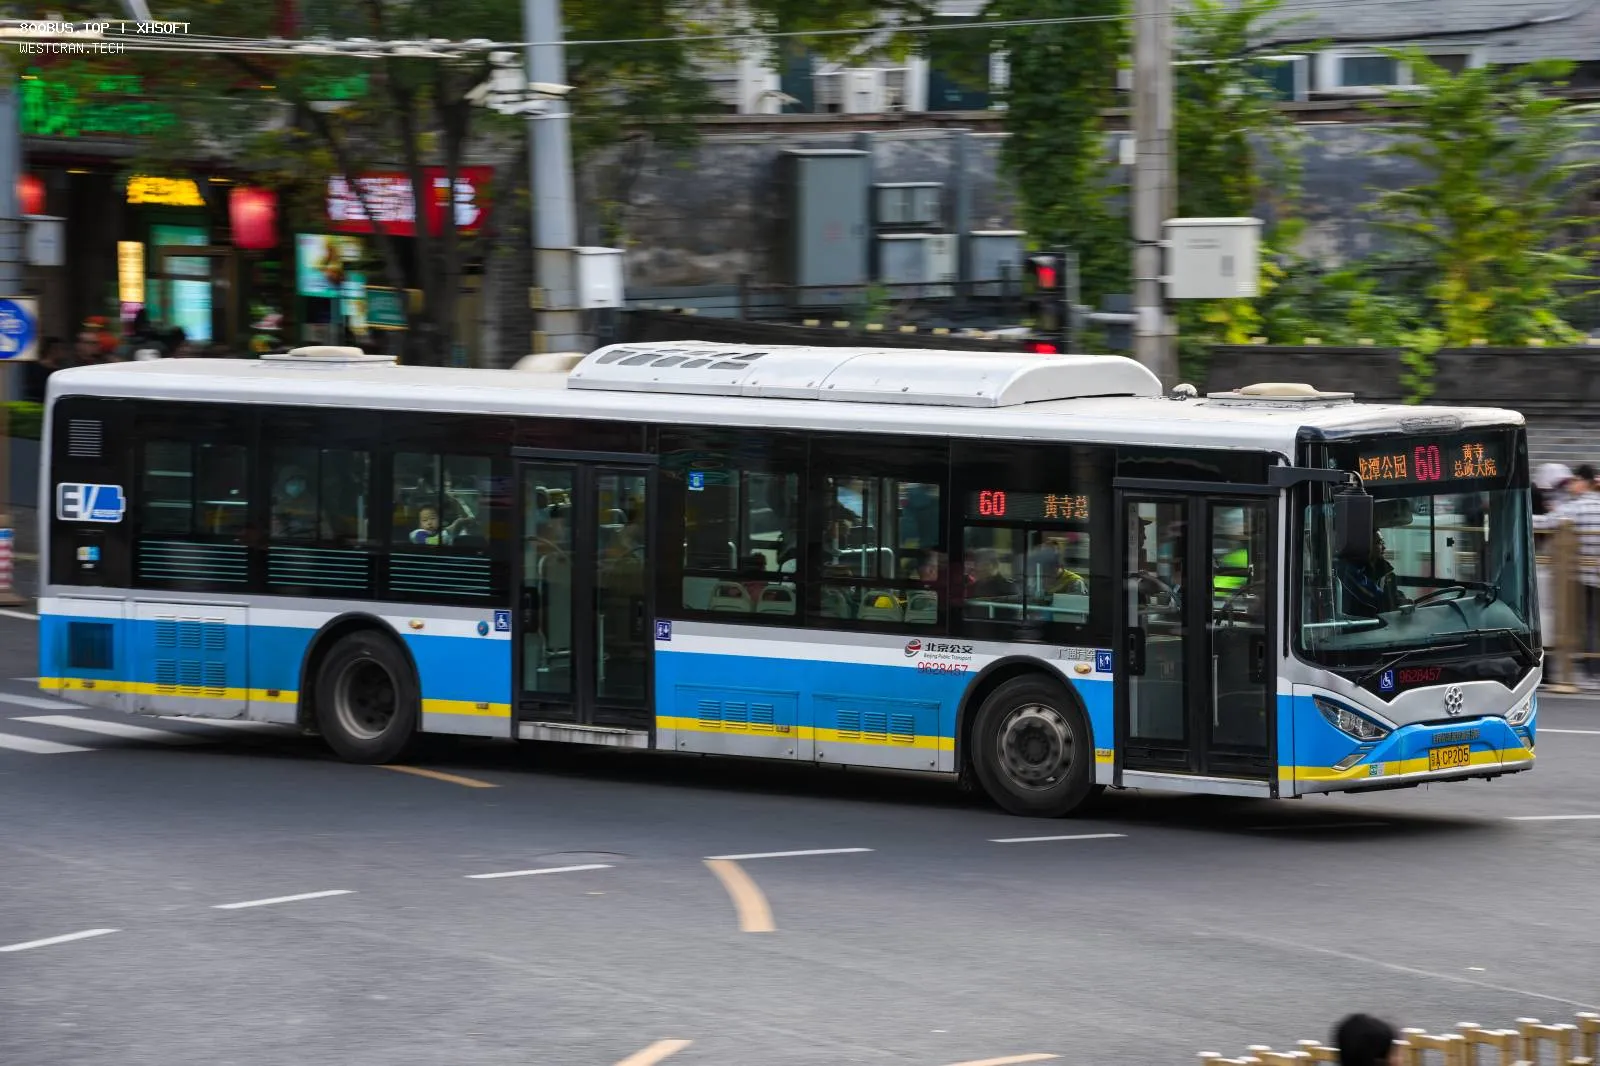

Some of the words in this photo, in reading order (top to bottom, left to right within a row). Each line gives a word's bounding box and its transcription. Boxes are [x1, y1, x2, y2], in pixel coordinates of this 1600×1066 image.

[1461, 444, 1484, 461] 黄寺
[1414, 446, 1440, 480] 60
[1455, 459, 1496, 477] 总政大院
[979, 490, 1005, 516] 60
[1044, 493, 1089, 518] 黄寺总
[925, 642, 973, 654] 北京公交
[918, 661, 968, 677] 9628457
[1400, 667, 1442, 683] 9628457
